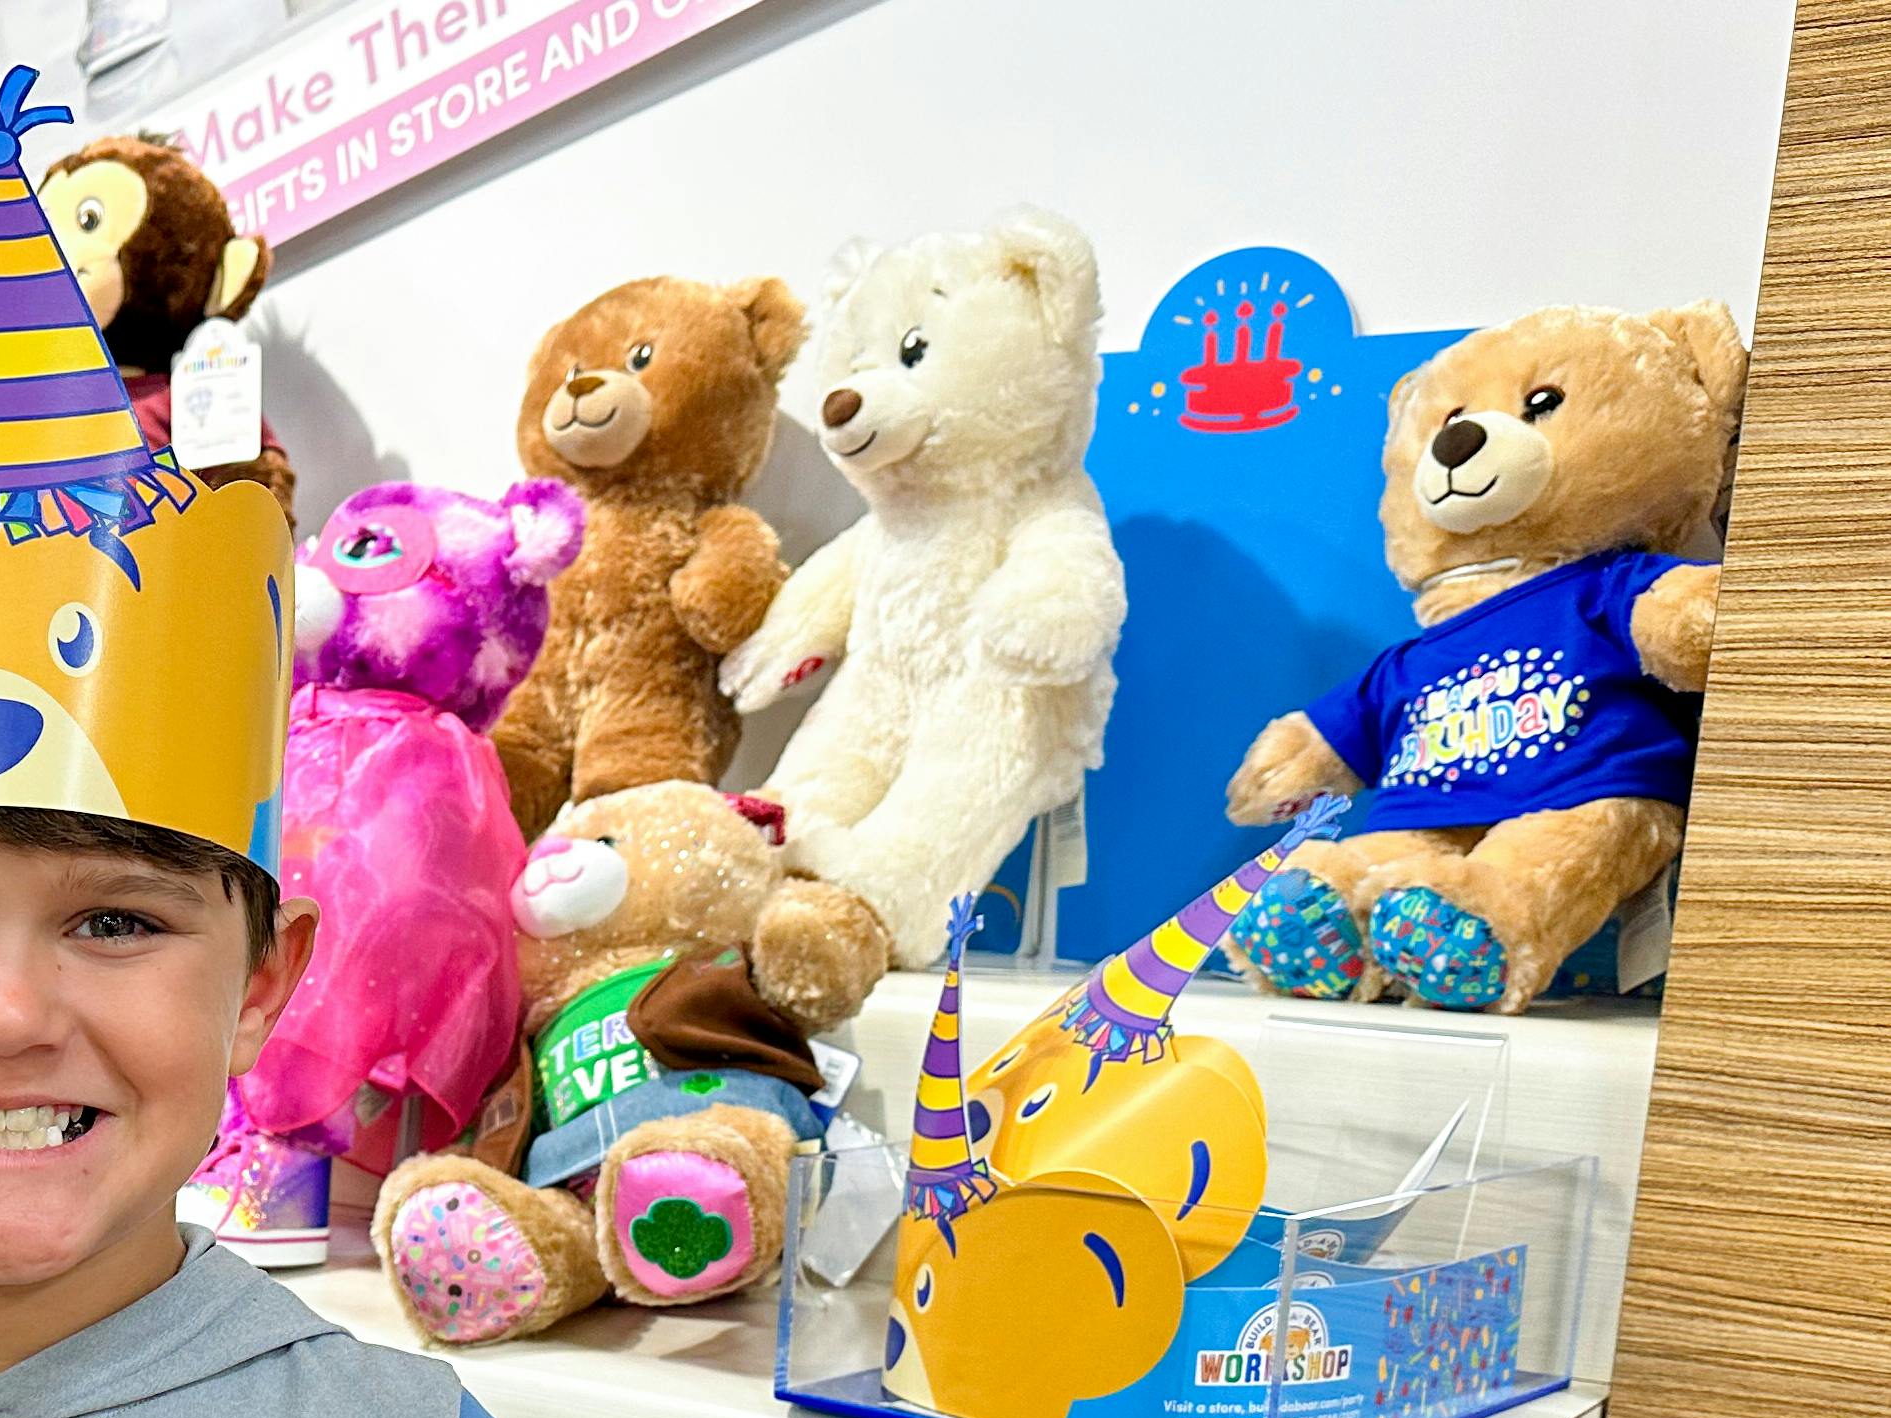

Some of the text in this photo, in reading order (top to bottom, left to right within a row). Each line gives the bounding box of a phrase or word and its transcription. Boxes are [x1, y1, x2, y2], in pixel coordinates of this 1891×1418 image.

[336, 130, 379, 185] IN
[388, 52, 532, 157] STORE
[539, 1, 640, 84] AND
[1164, 1400, 1192, 1414] Visit
[1196, 1404, 1205, 1414] a
[1209, 1402, 1245, 1415] store,
